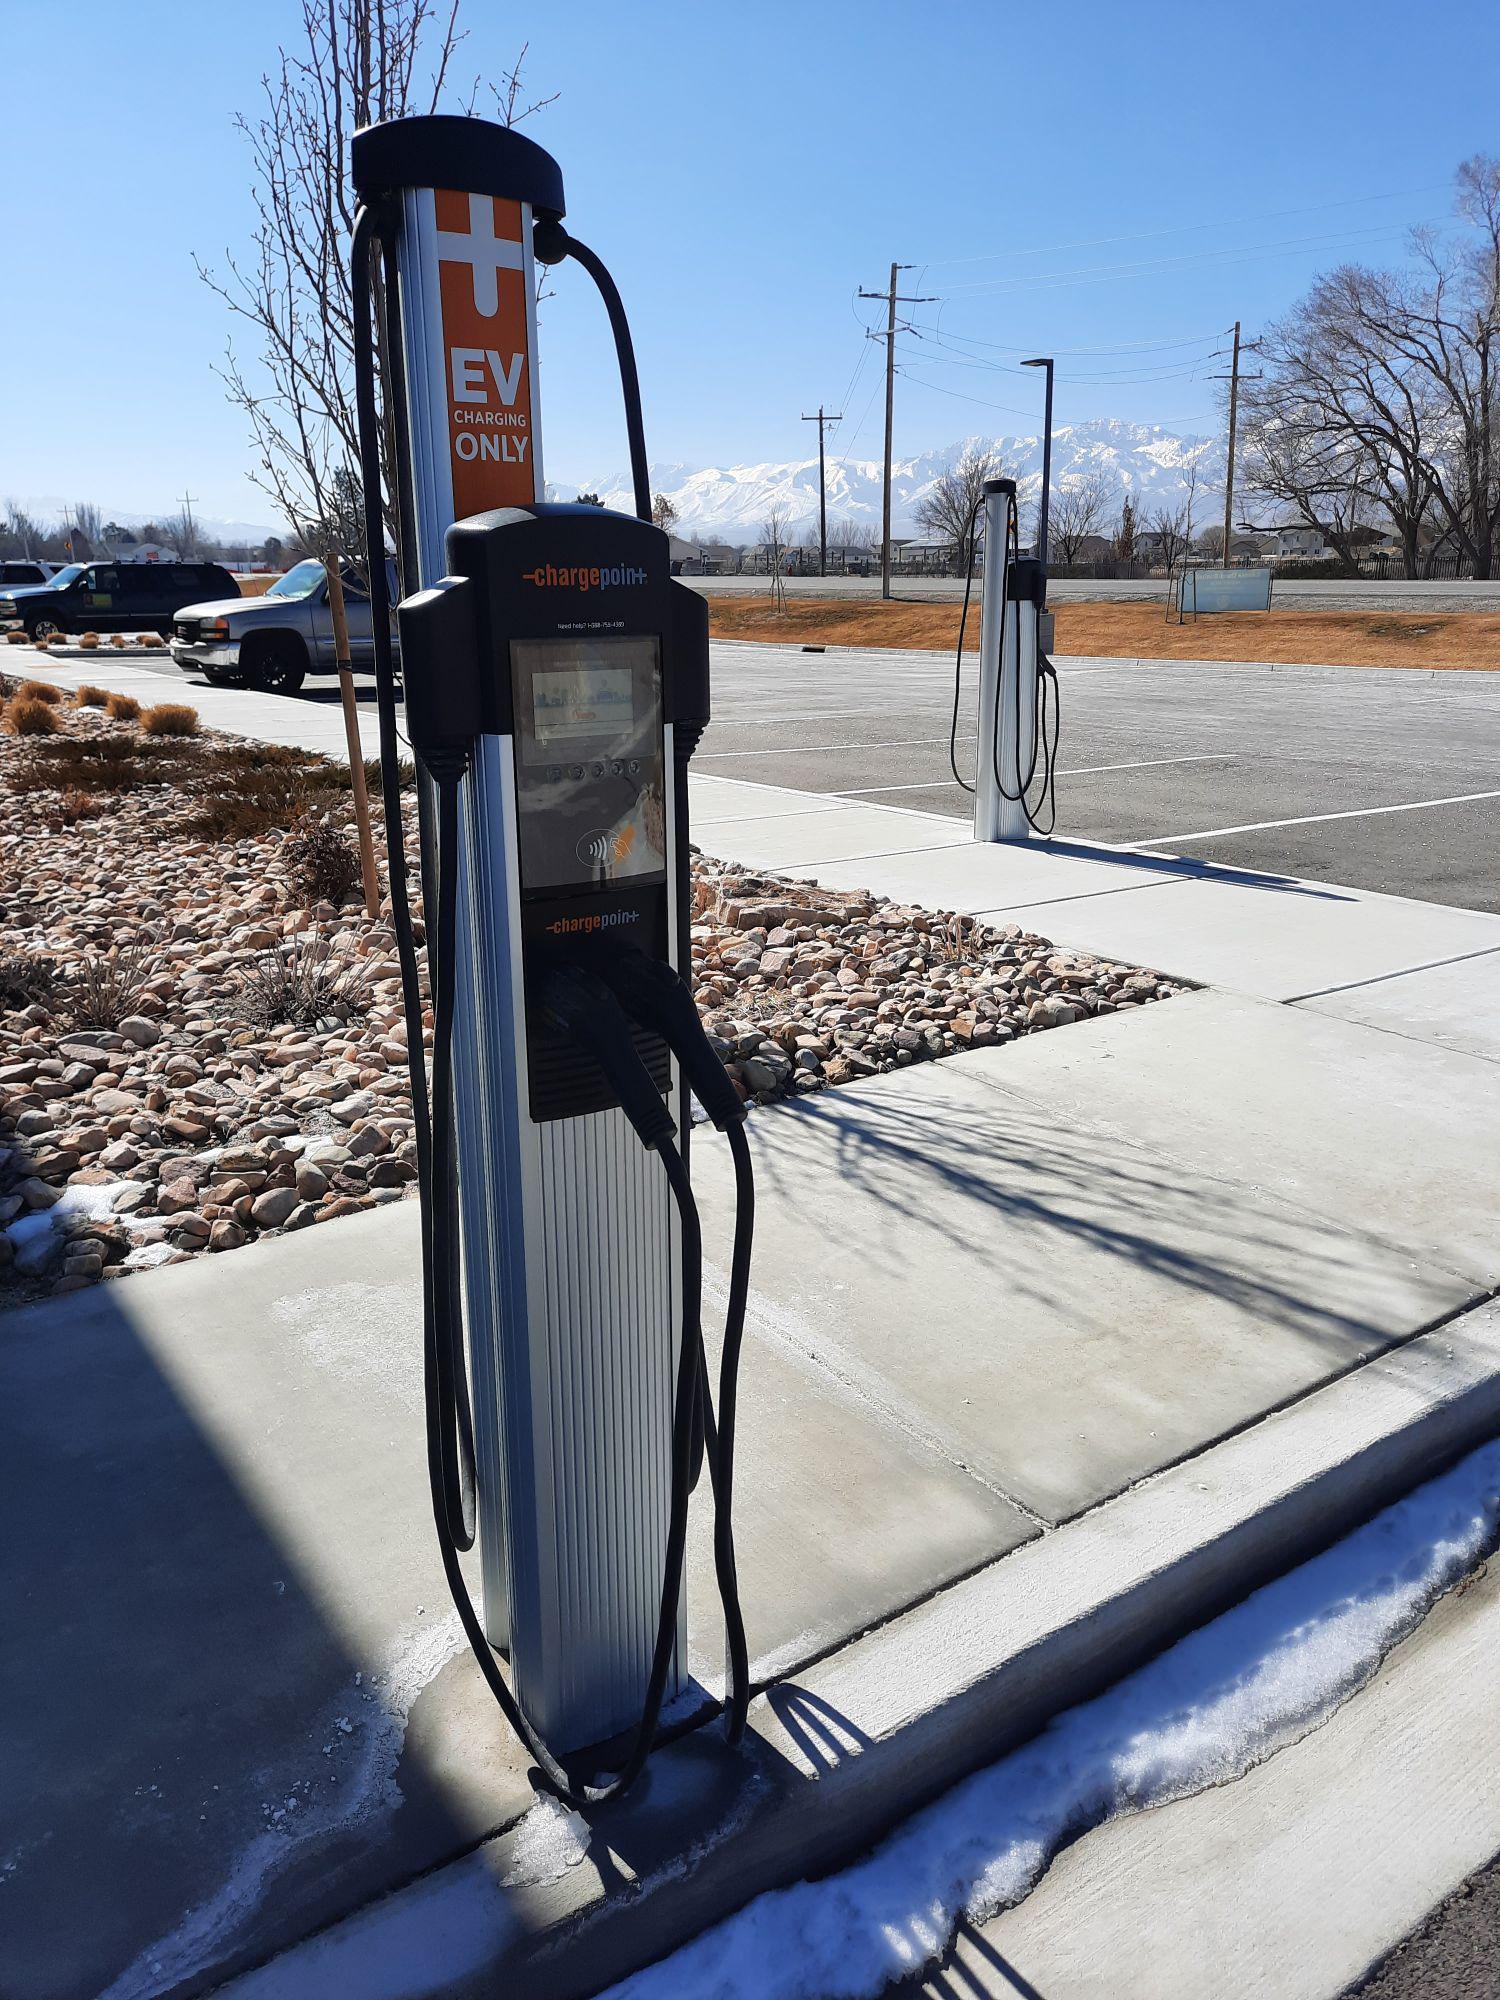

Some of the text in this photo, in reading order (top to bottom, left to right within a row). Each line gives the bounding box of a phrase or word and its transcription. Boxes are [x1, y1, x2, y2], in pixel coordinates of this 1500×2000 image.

[450, 346, 525, 406] EV
[453, 409, 527, 428] CHARGING
[455, 431, 529, 463] ONLY
